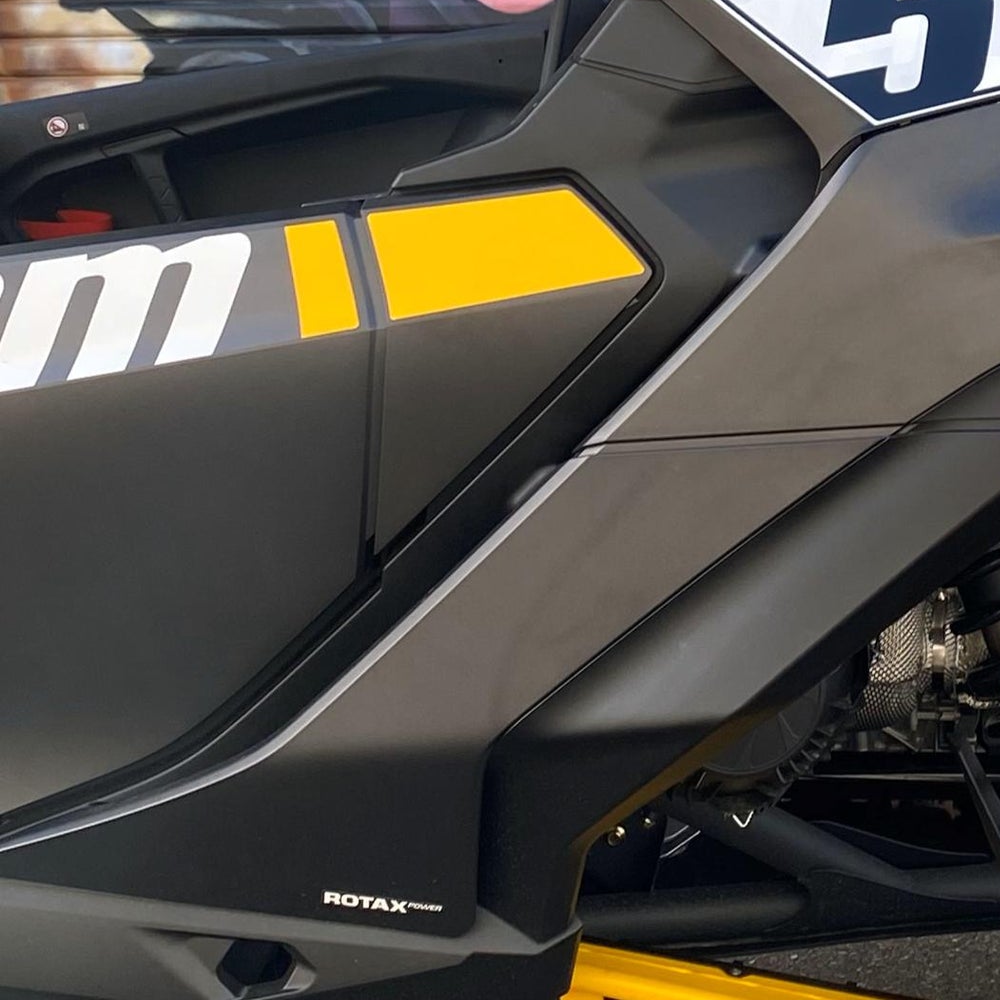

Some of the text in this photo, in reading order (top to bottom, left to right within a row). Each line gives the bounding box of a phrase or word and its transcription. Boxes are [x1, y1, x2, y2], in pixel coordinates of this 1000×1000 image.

[0, 232, 251, 392] m
[323, 891, 444, 914] ROTAX POWER
